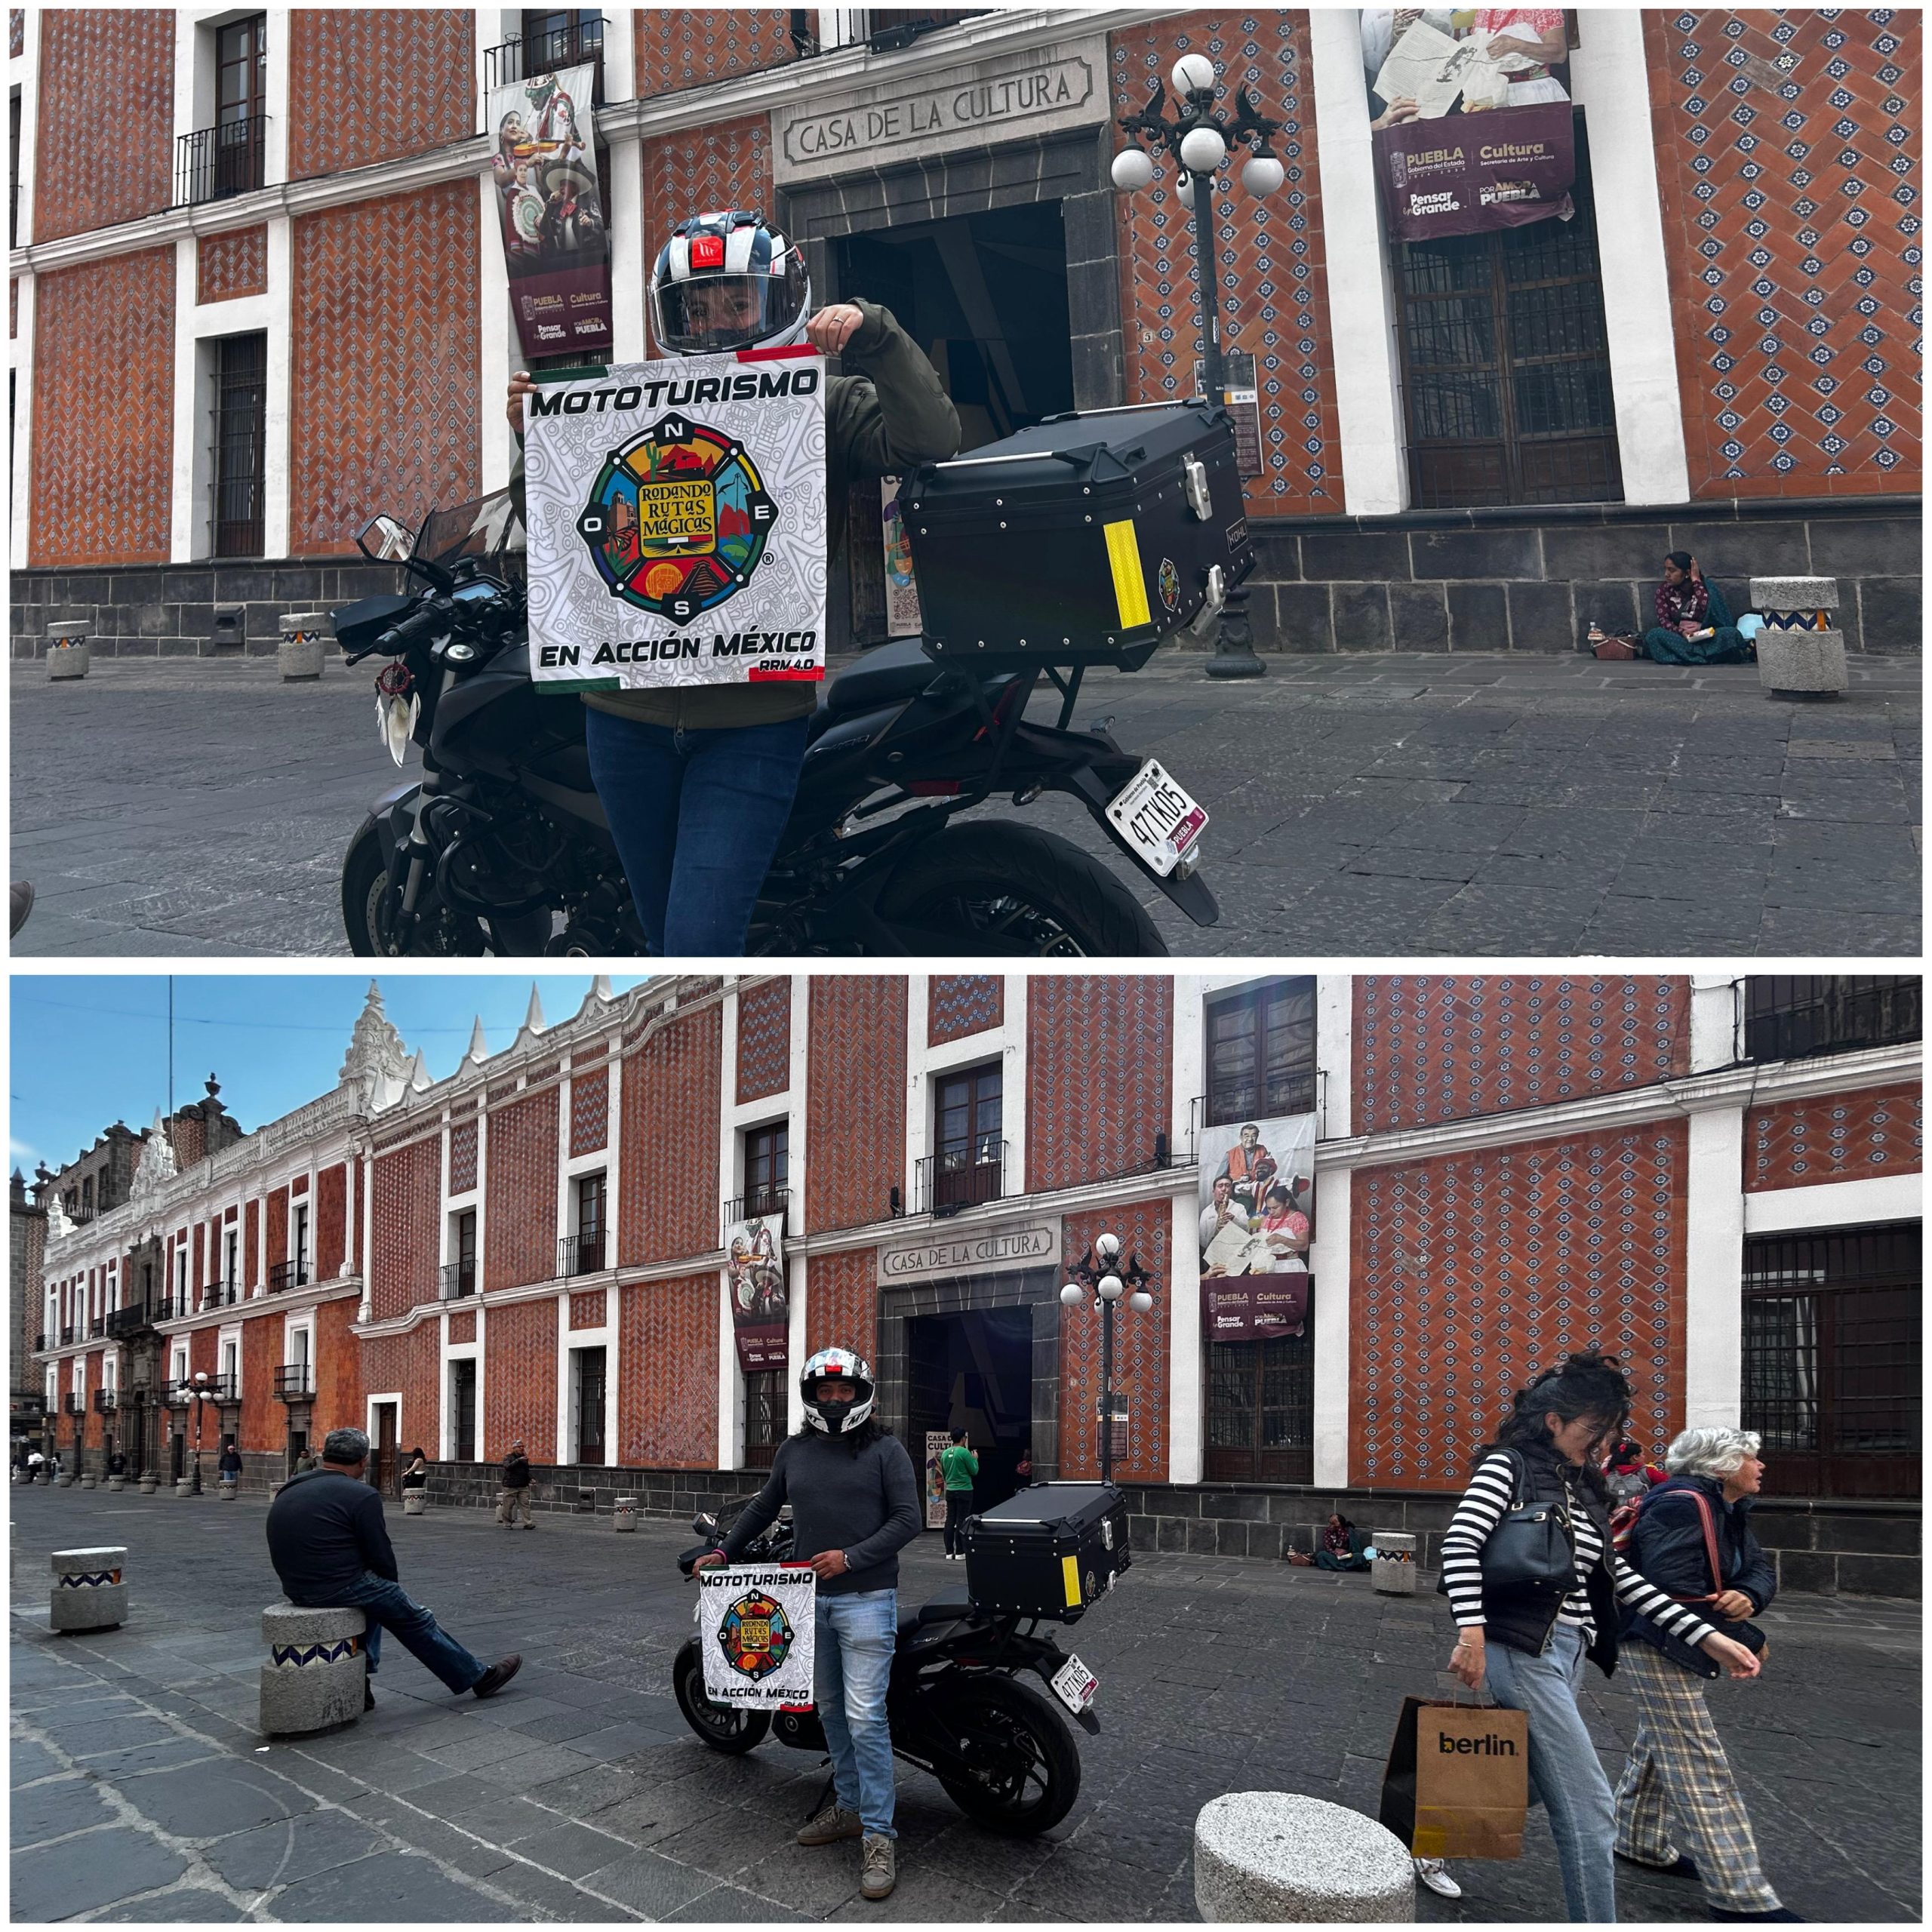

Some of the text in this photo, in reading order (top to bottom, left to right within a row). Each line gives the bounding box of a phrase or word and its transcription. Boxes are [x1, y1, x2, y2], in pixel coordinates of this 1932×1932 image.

[799, 72, 1071, 153] CASA DE LA CULTURA
[1407, 147, 1464, 167] PUEBLA
[1480, 143, 1544, 158] Cultura
[1444, 159, 1465, 168] Estado
[1495, 180, 1531, 192] AMOR
[1410, 191, 1453, 206] Pensar
[1480, 188, 1541, 205] PUEBLA
[1412, 199, 1460, 216] Grande
[534, 294, 563, 305] PUEBLA
[570, 292, 601, 303] Cultura
[538, 325, 561, 333] Pensar
[540, 330, 566, 340] Grande
[575, 323, 608, 334] PUEBLA
[1145, 333, 1151, 341] 5
[530, 368, 819, 417] MOTOTURISMO
[665, 423, 684, 438] N
[755, 505, 770, 520] E
[584, 518, 601, 531] O
[674, 601, 689, 615] S
[540, 625, 817, 667] EN ACCIÓN MÉXICO
[758, 659, 814, 672] RRM 4.0
[1130, 783, 1187, 847] 47TKD5
[1173, 821, 1193, 844] PUEBLA
[892, 1235, 1041, 1271] CASA DE LA CULTURA
[1217, 1293, 1248, 1301] PUEBLA
[700, 1572, 813, 1587] MOTOTURISMO
[708, 1684, 809, 1700] EN ACCIÓN MÉXICO
